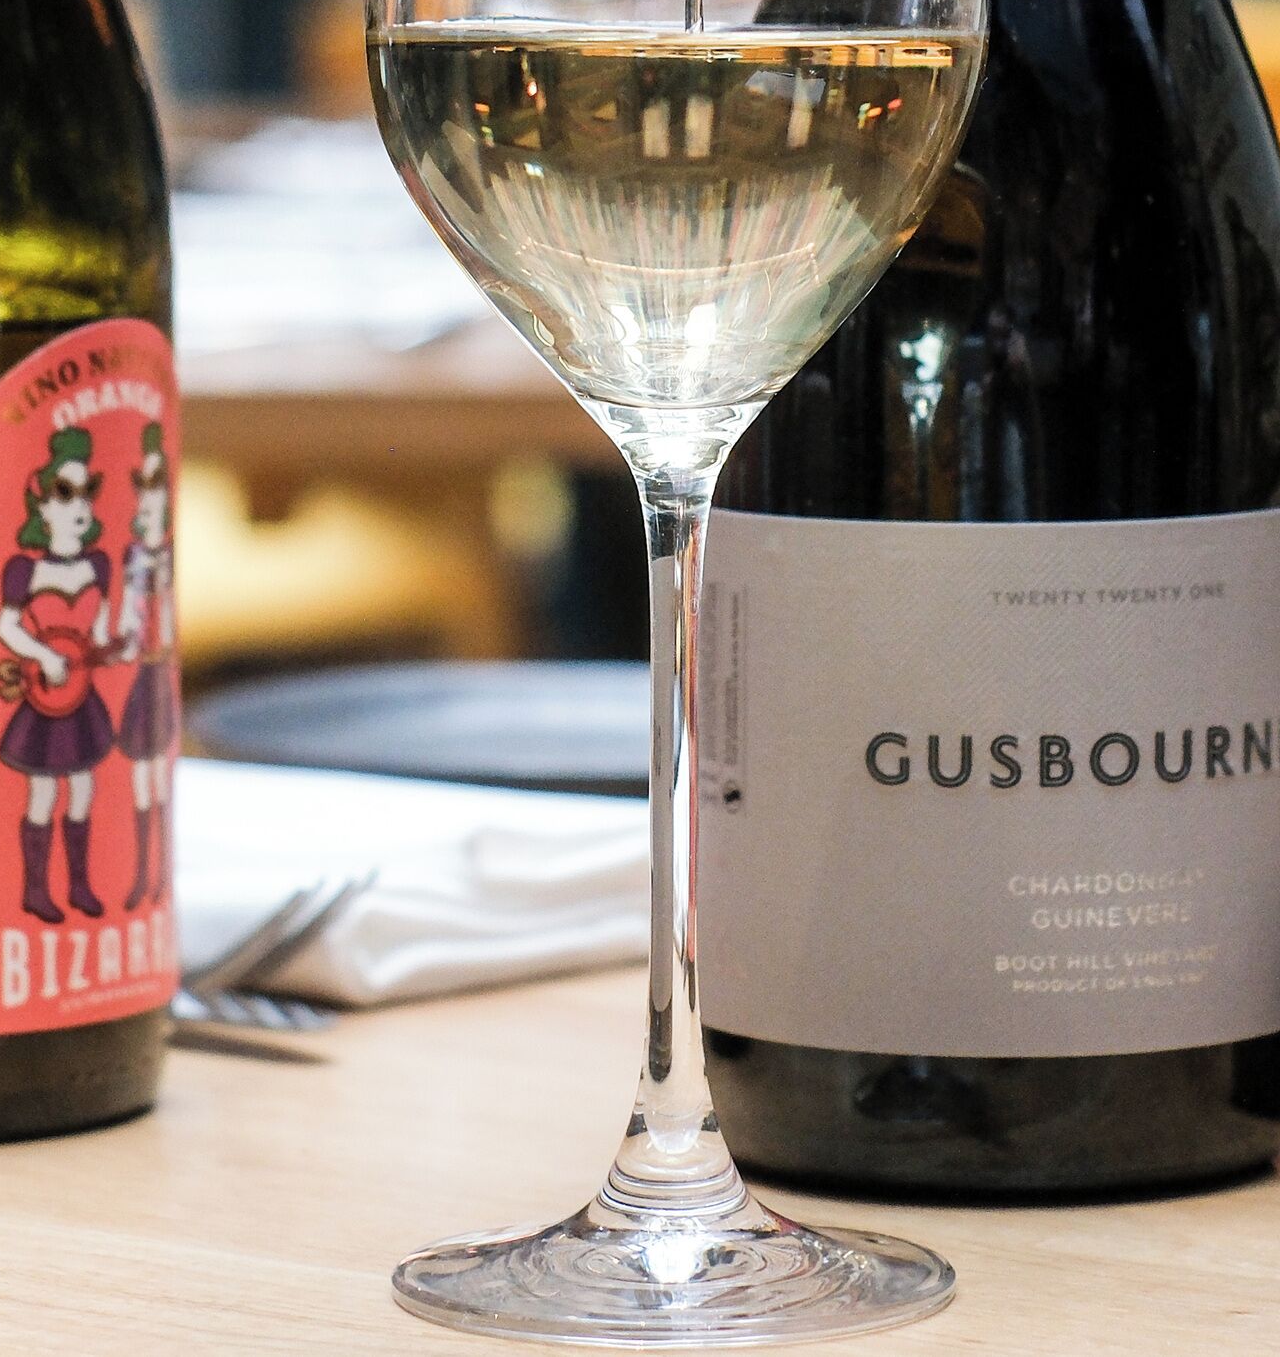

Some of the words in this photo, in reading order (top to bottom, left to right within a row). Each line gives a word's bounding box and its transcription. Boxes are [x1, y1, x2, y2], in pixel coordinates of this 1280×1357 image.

[988, 589, 1087, 606] TWENTY
[1095, 585, 1183, 604] TWENTY
[1188, 580, 1227, 601] ONE
[993, 953, 1059, 973] BOOT
